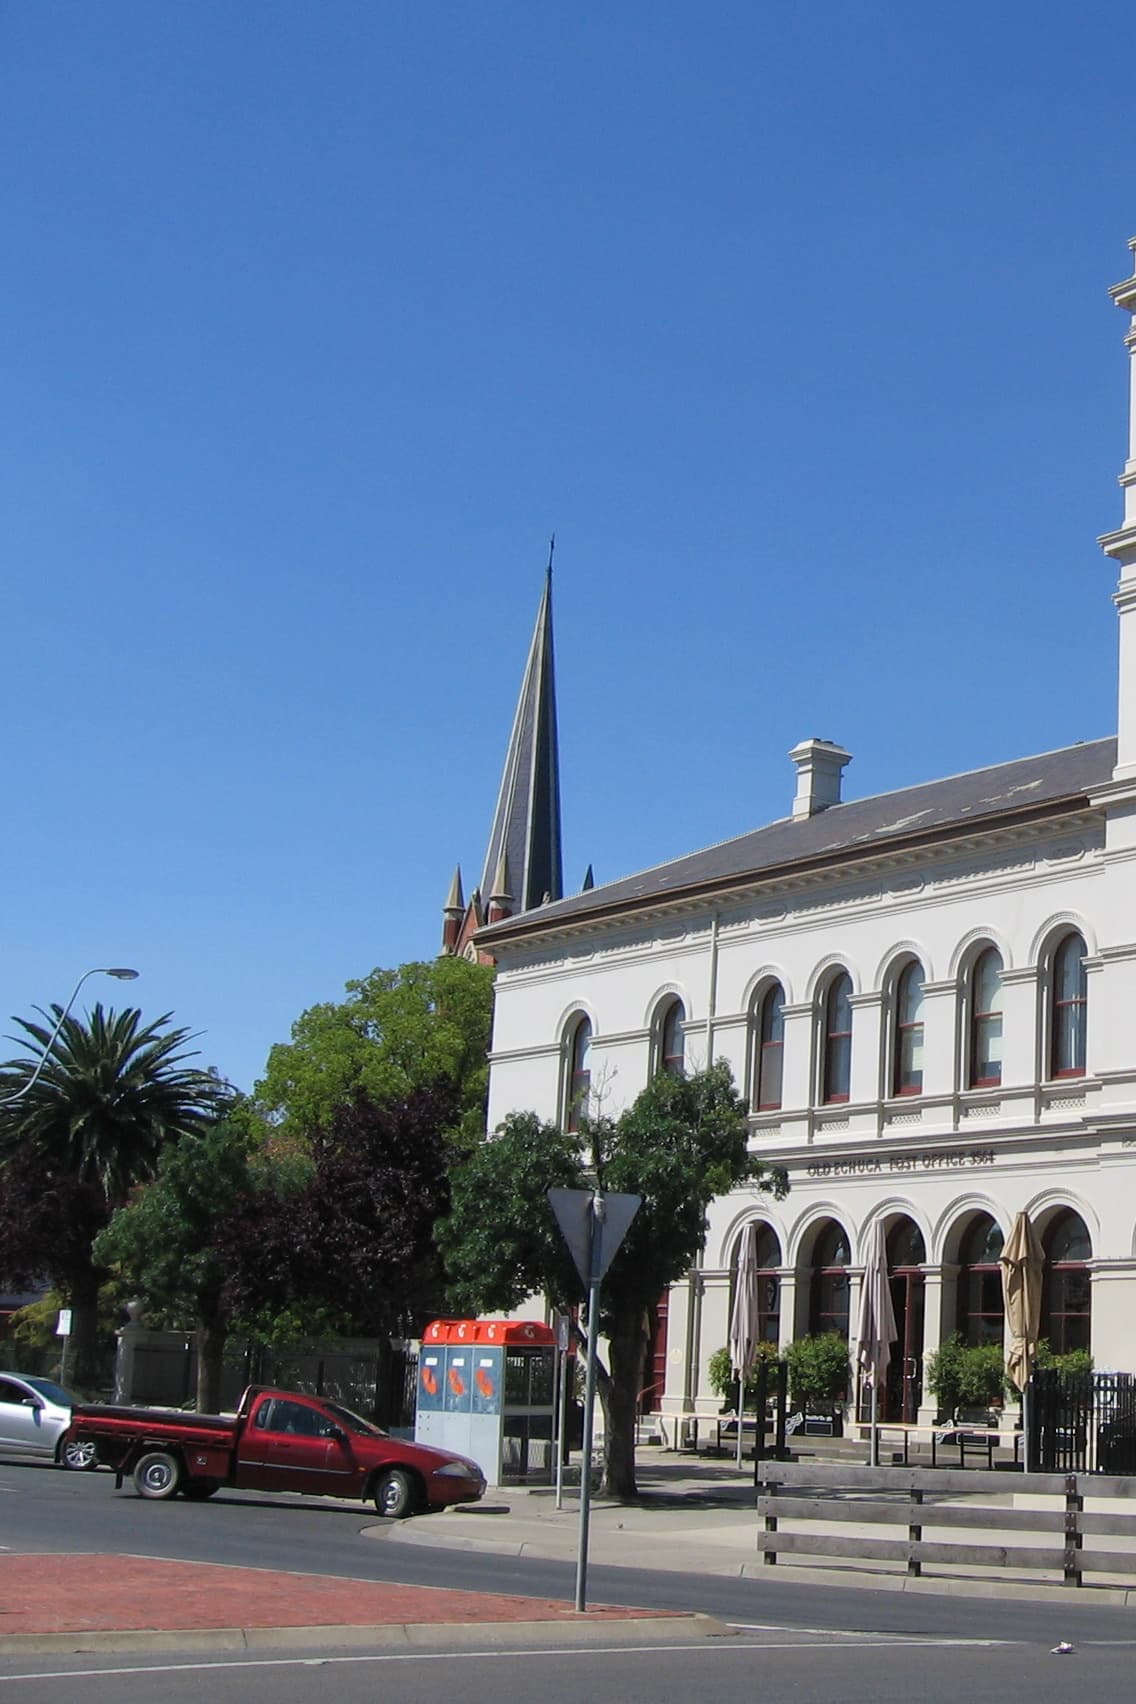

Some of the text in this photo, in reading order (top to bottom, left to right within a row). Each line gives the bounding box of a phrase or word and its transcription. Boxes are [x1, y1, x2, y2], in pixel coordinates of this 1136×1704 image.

[808, 1163, 831, 1177] OLD
[834, 1159, 882, 1175] ECHUCA
[889, 1156, 919, 1171] POST
[922, 1152, 966, 1168] OFFICE
